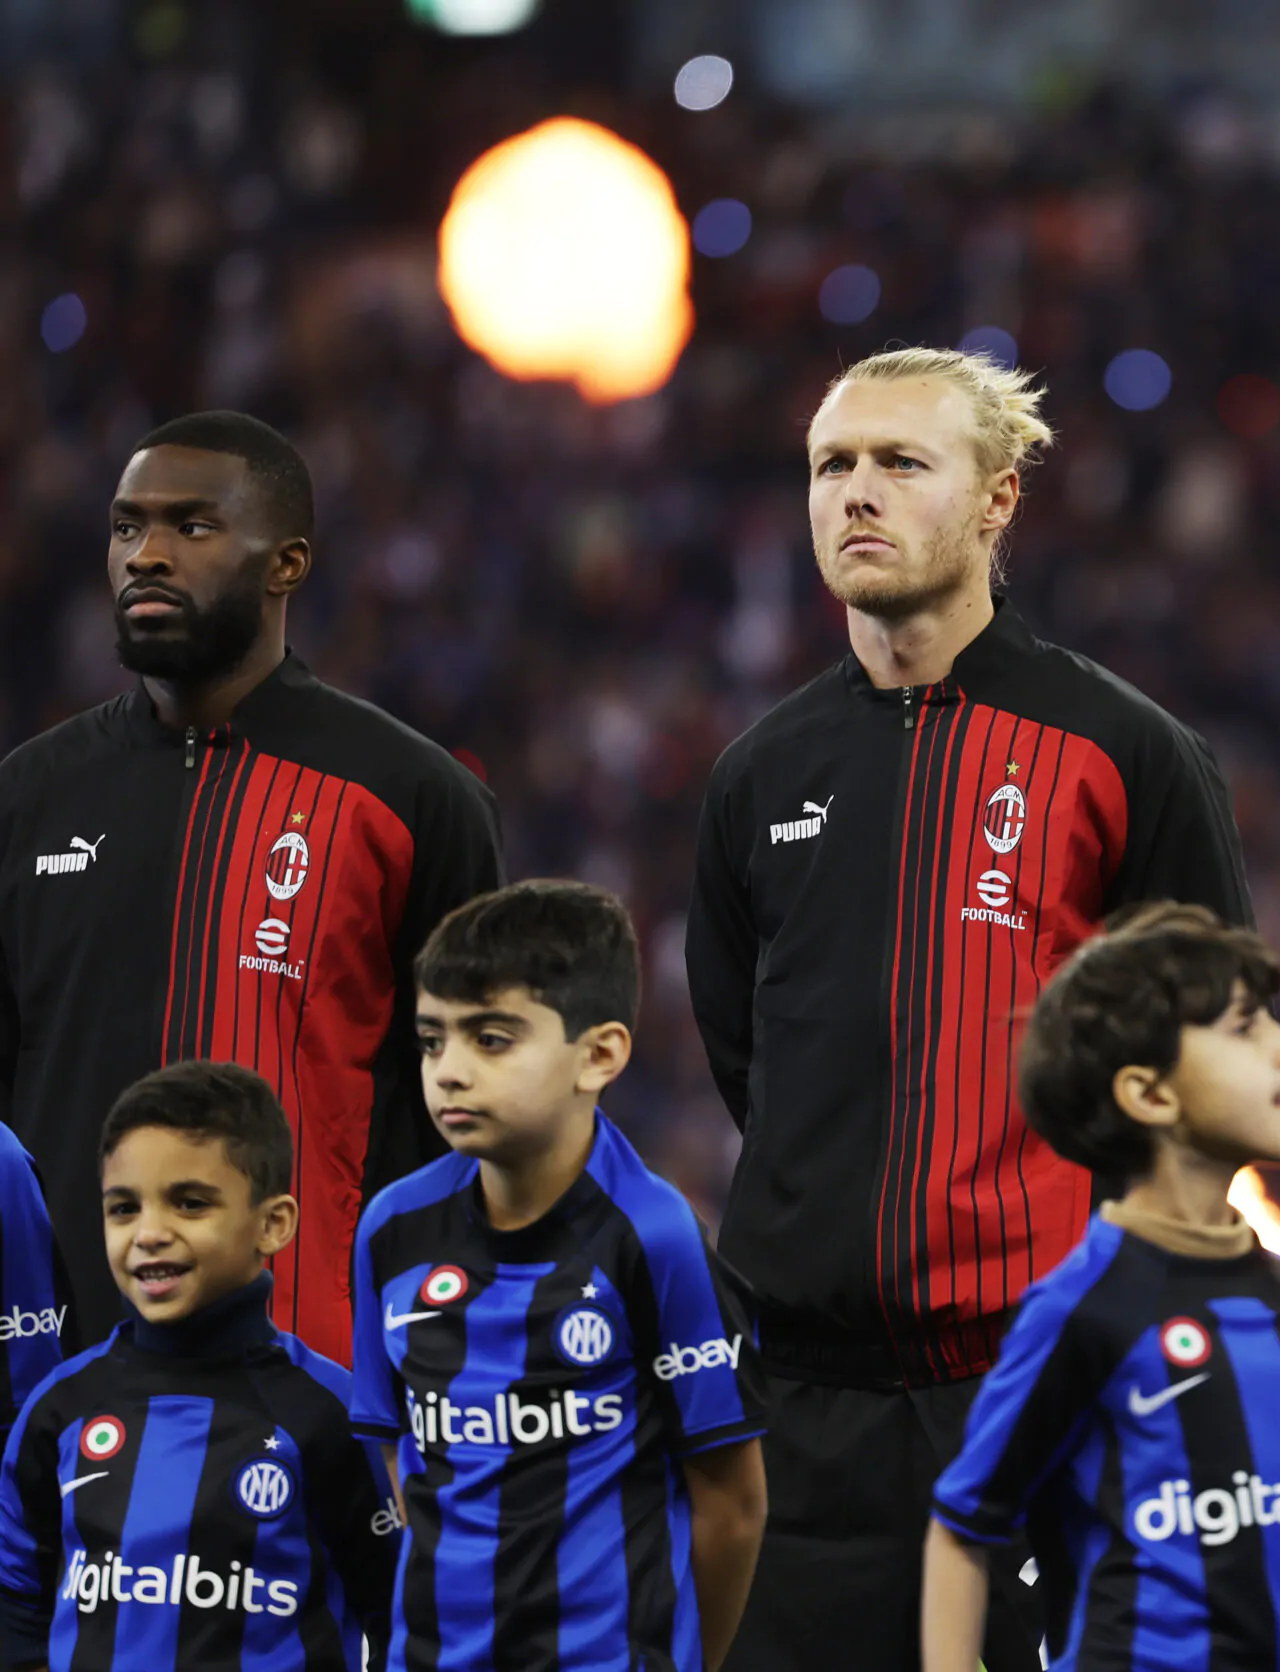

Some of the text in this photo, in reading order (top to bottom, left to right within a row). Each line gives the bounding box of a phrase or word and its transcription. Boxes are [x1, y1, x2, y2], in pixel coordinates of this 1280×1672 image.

[995, 786, 1021, 801] ACM
[280, 834, 305, 850] ACM
[769, 816, 821, 845] PUMA
[989, 837, 1013, 850] 1899
[35, 852, 88, 876] PUMA
[960, 907, 1026, 930] FOOTBALL
[238, 954, 302, 980] FOOTBALL
[0, 1305, 67, 1340] ebay
[653, 1333, 742, 1381] ebay
[407, 1389, 622, 1453] gitalbits
